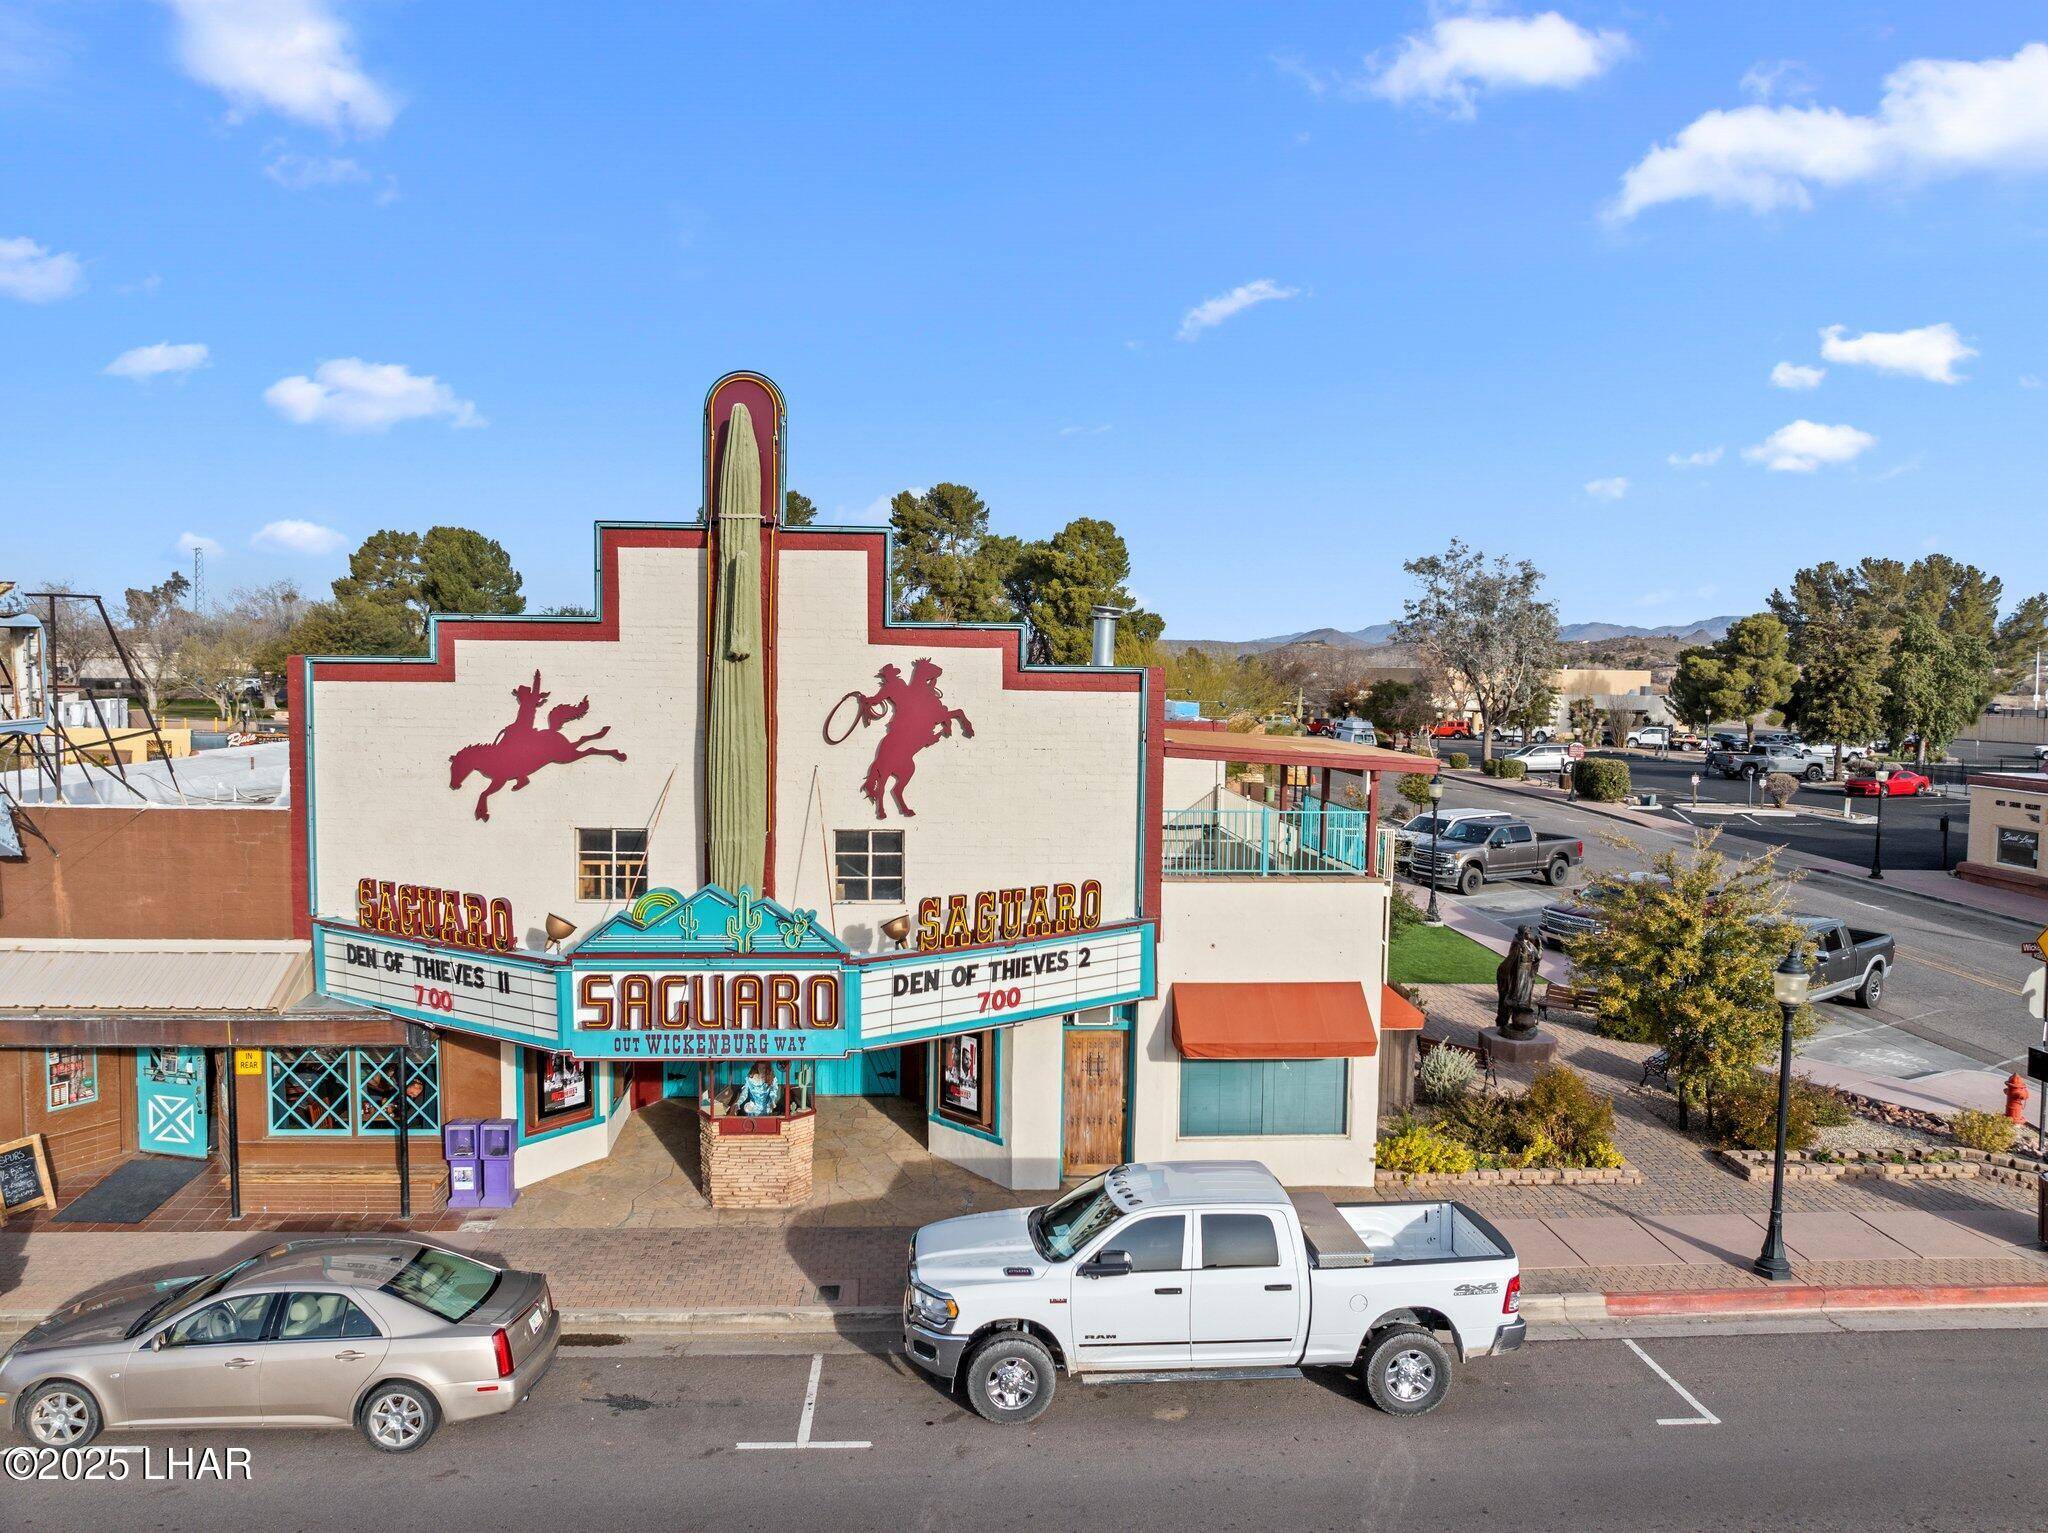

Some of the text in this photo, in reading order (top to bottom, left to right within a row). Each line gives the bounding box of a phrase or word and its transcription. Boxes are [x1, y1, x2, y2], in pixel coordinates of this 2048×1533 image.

[359, 877, 515, 952] SAGUARO
[917, 879, 1102, 951] SAGUARO
[346, 943, 377, 969] DEN
[384, 951, 404, 973] OF
[413, 955, 485, 989] THIEVES
[893, 947, 1091, 997] DEN OF THIEVES 2
[579, 974, 839, 1031] SAGUARO
[977, 986, 1022, 1013] 700
[240, 1061, 258, 1069] REAR
[245, 1052, 253, 1060] IN
[613, 1033, 807, 1054] OUT WICKENBURG WAY
